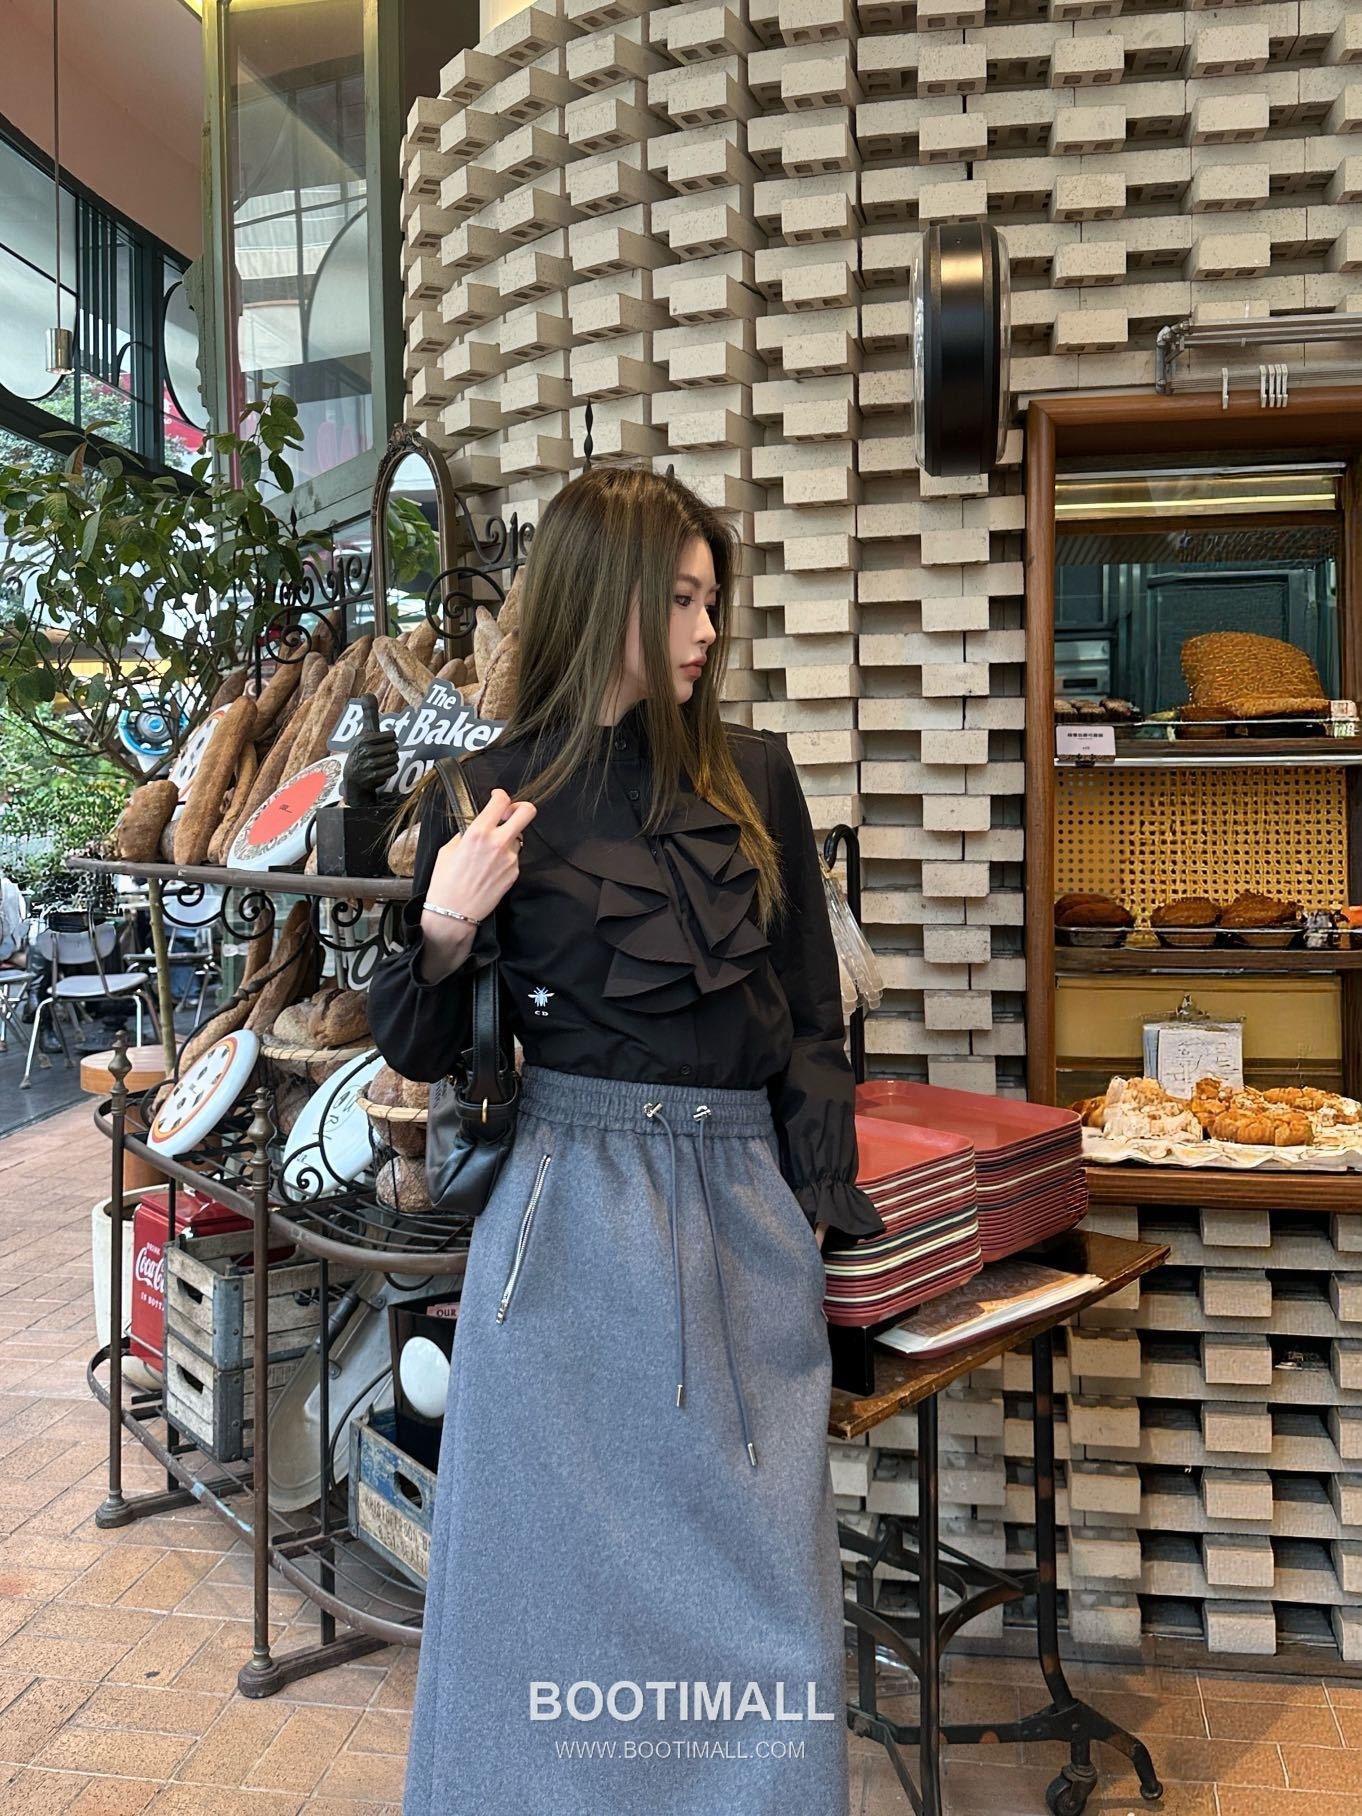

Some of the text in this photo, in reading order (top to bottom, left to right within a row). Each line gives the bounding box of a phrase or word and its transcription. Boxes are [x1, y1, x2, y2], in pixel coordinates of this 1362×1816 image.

[426, 684, 456, 709] The
[331, 704, 410, 743] Bst
[384, 749, 434, 794] To
[146, 1242, 161, 1255] DRINK
[436, 1309, 457, 1317] OUR
